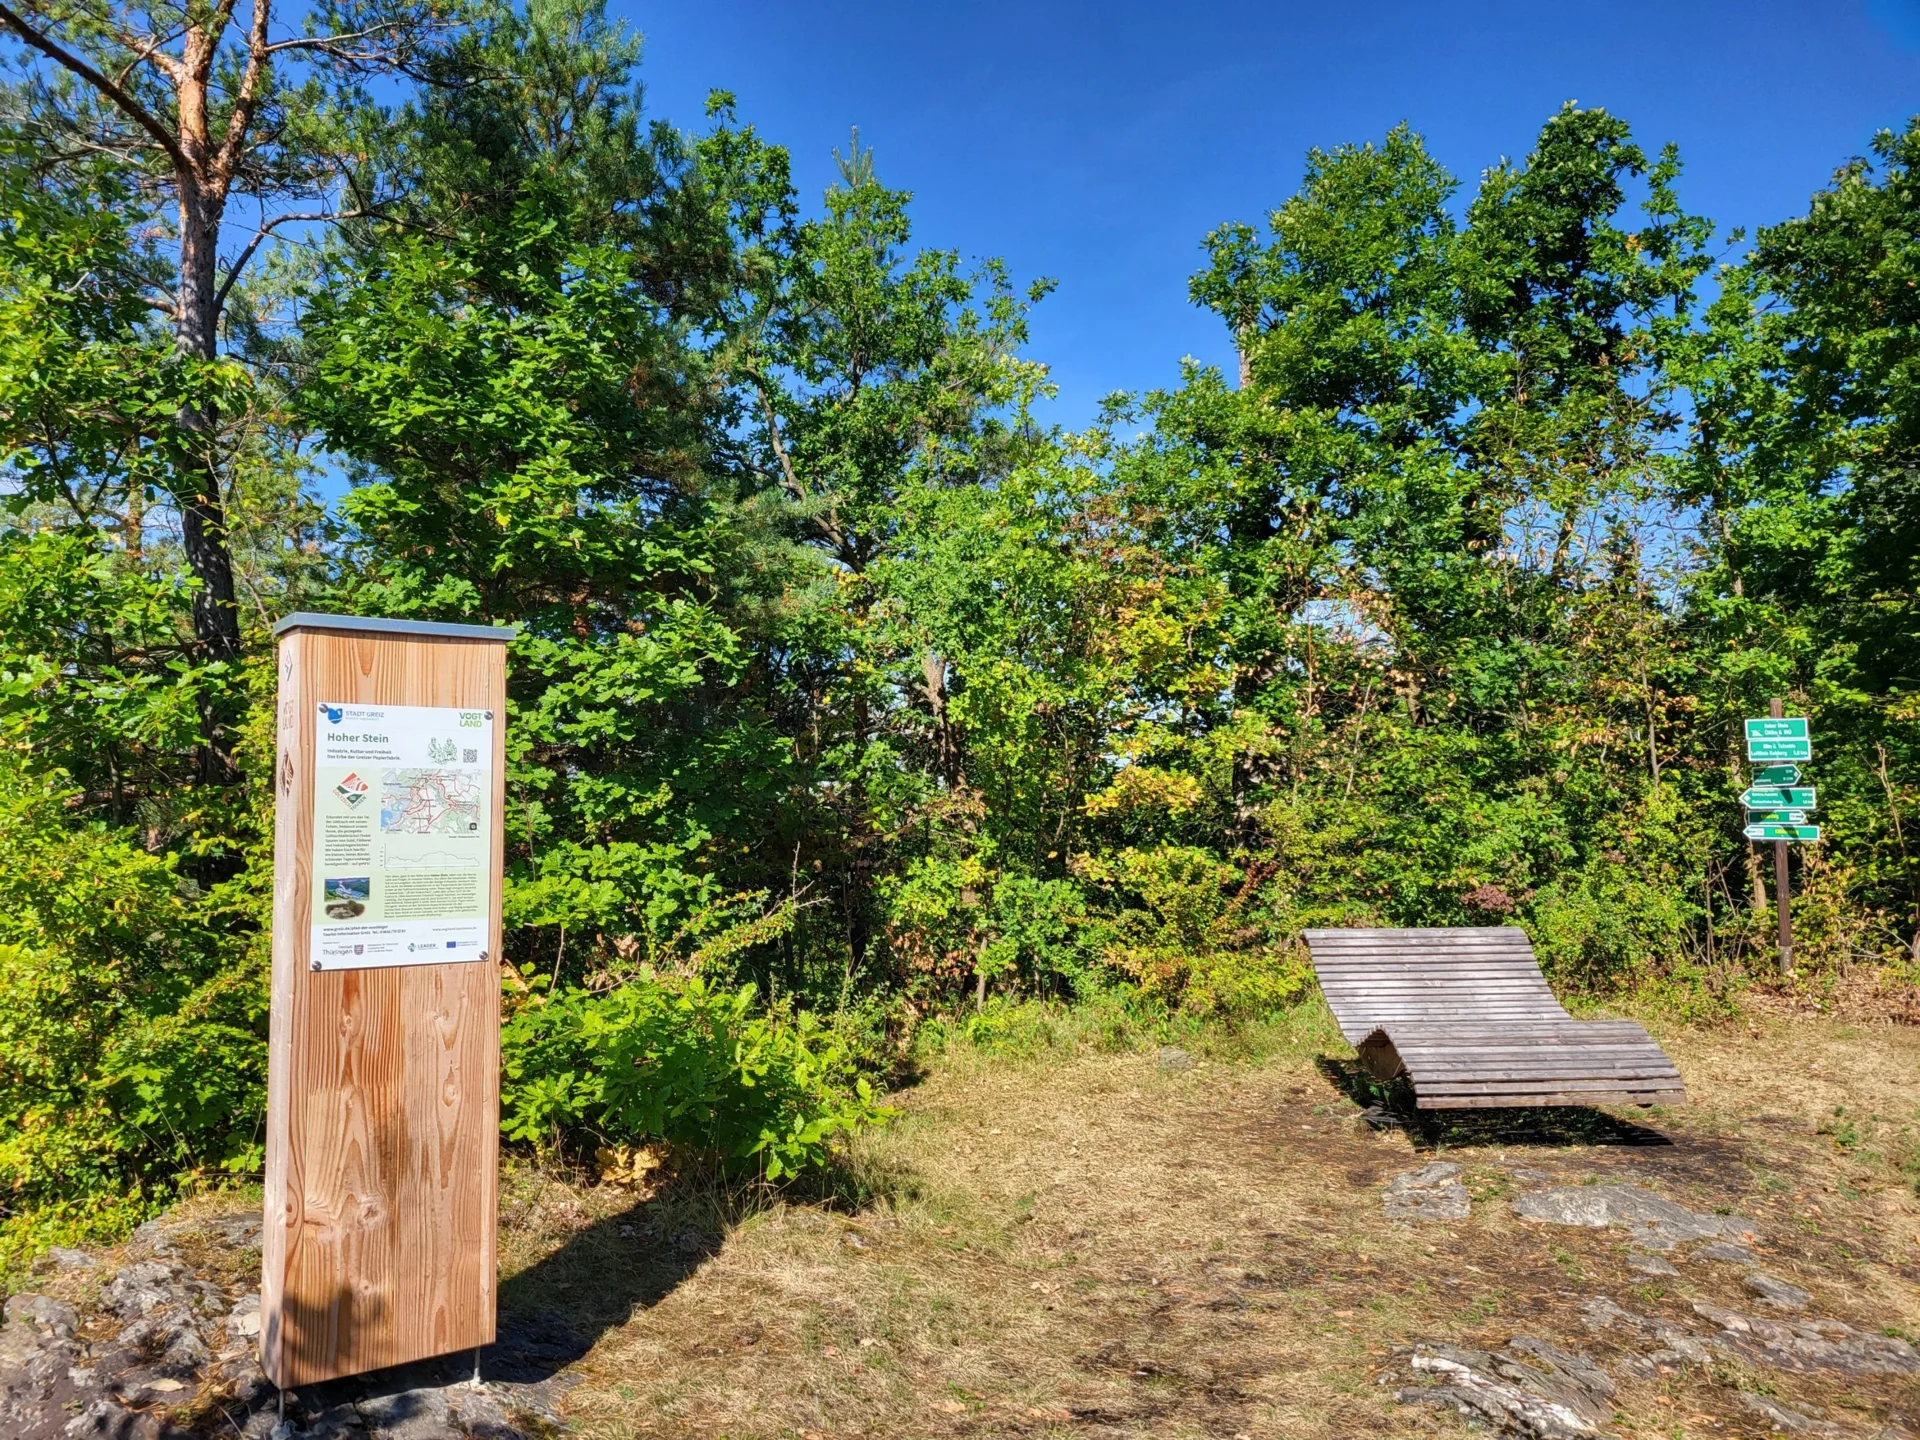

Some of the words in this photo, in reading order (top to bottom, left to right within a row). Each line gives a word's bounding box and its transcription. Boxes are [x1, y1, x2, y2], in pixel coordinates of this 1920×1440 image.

[459, 712, 482, 720] VOGT
[327, 732, 360, 742] Hoher
[362, 733, 389, 743] Stein
